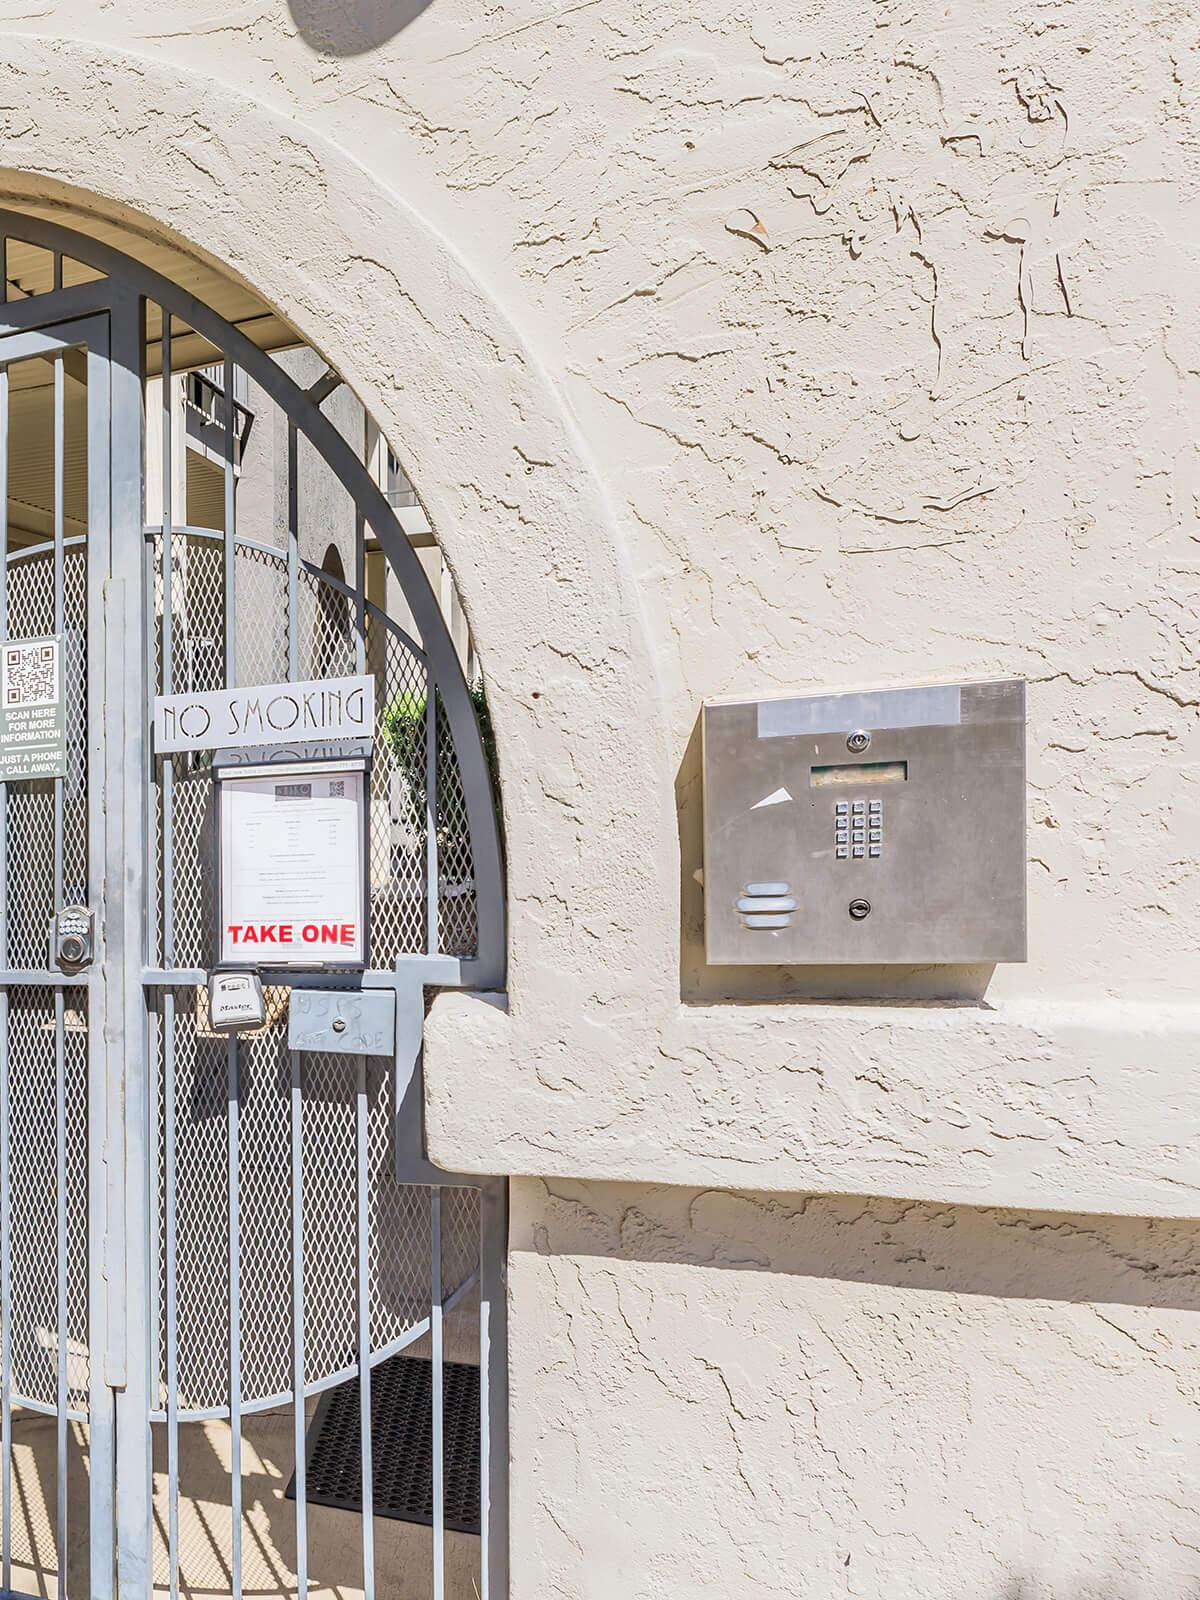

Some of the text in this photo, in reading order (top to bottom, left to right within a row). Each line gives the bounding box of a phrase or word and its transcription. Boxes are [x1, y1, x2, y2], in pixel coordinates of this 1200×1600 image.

[5, 707, 57, 721] SCAN HERE
[163, 688, 364, 741] NO SMOKING
[8, 718, 56, 732] FOR MORE
[0, 729, 61, 743] INFORMATION
[0, 751, 63, 765] JUST A PHONE
[6, 762, 56, 775] CALL AWAY
[227, 923, 356, 944] TAKE ONE
